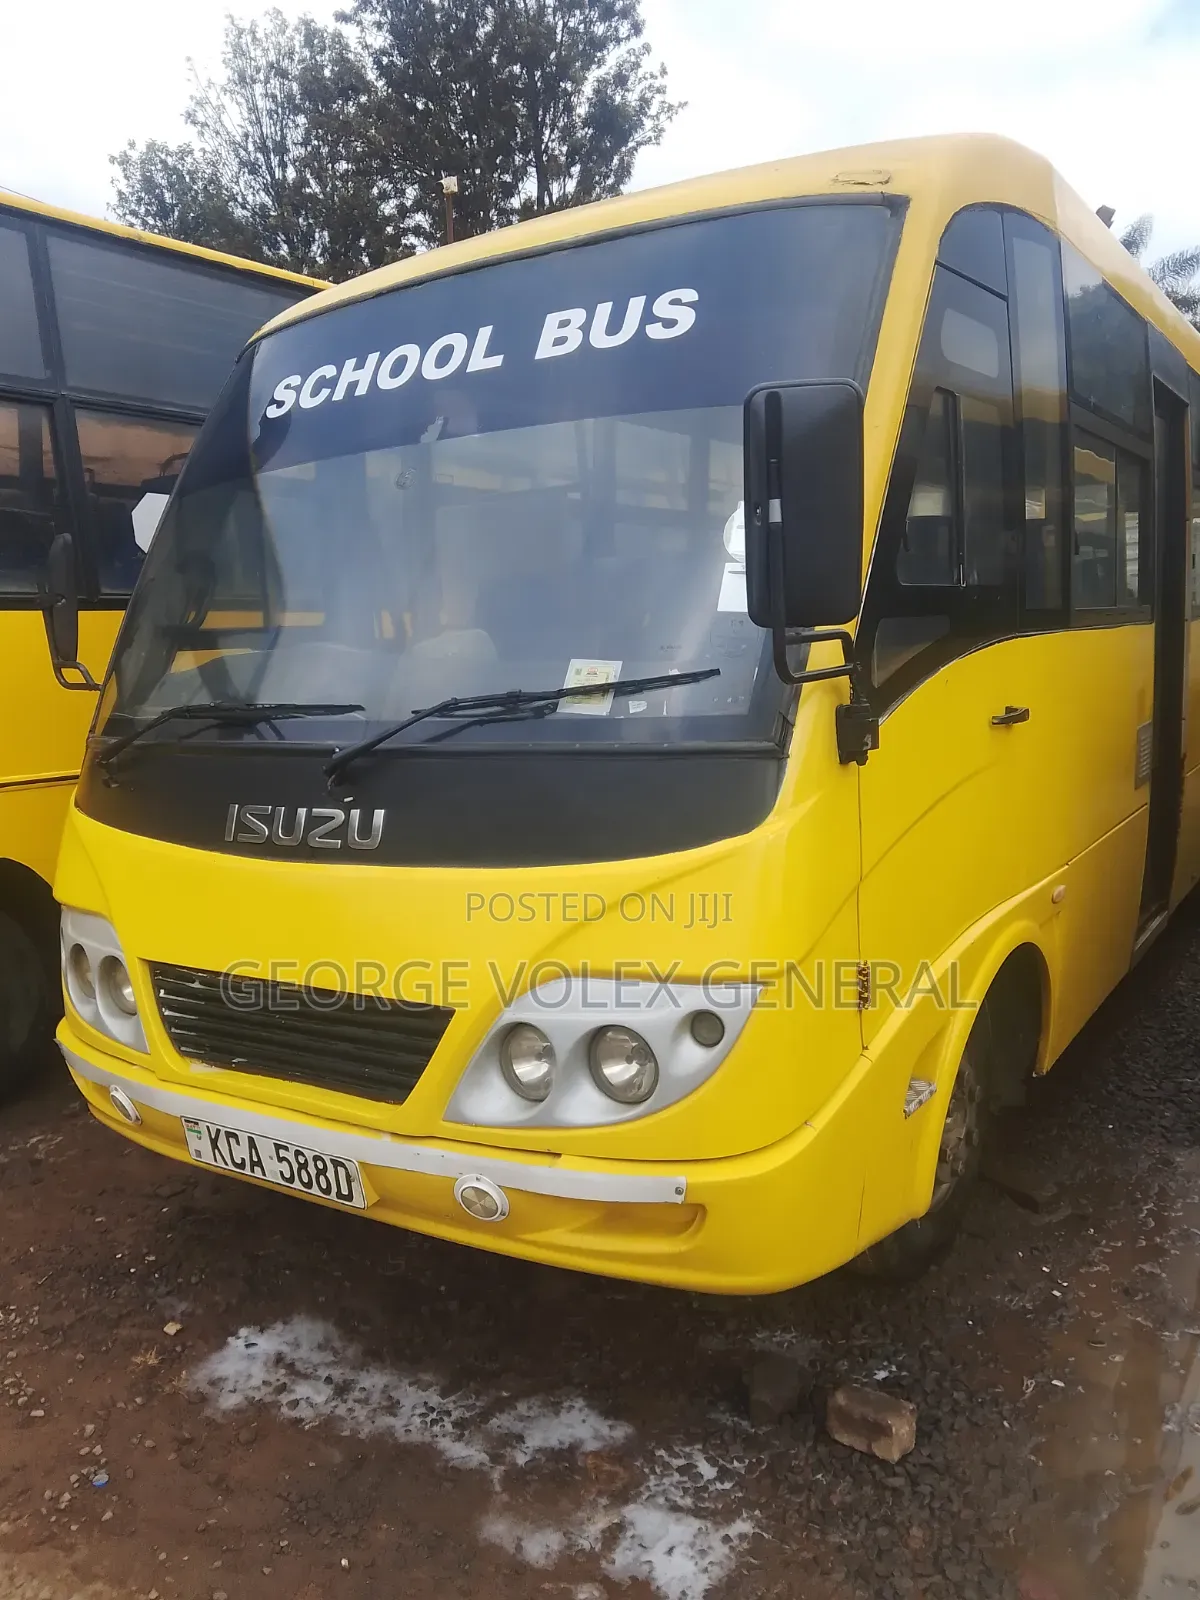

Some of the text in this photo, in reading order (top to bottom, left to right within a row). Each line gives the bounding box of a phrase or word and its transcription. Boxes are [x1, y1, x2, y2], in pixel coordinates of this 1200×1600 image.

[265, 288, 699, 418] SCHOOL BUS
[224, 804, 385, 850] ISUZU
[206, 1125, 354, 1202] KCA 588D
